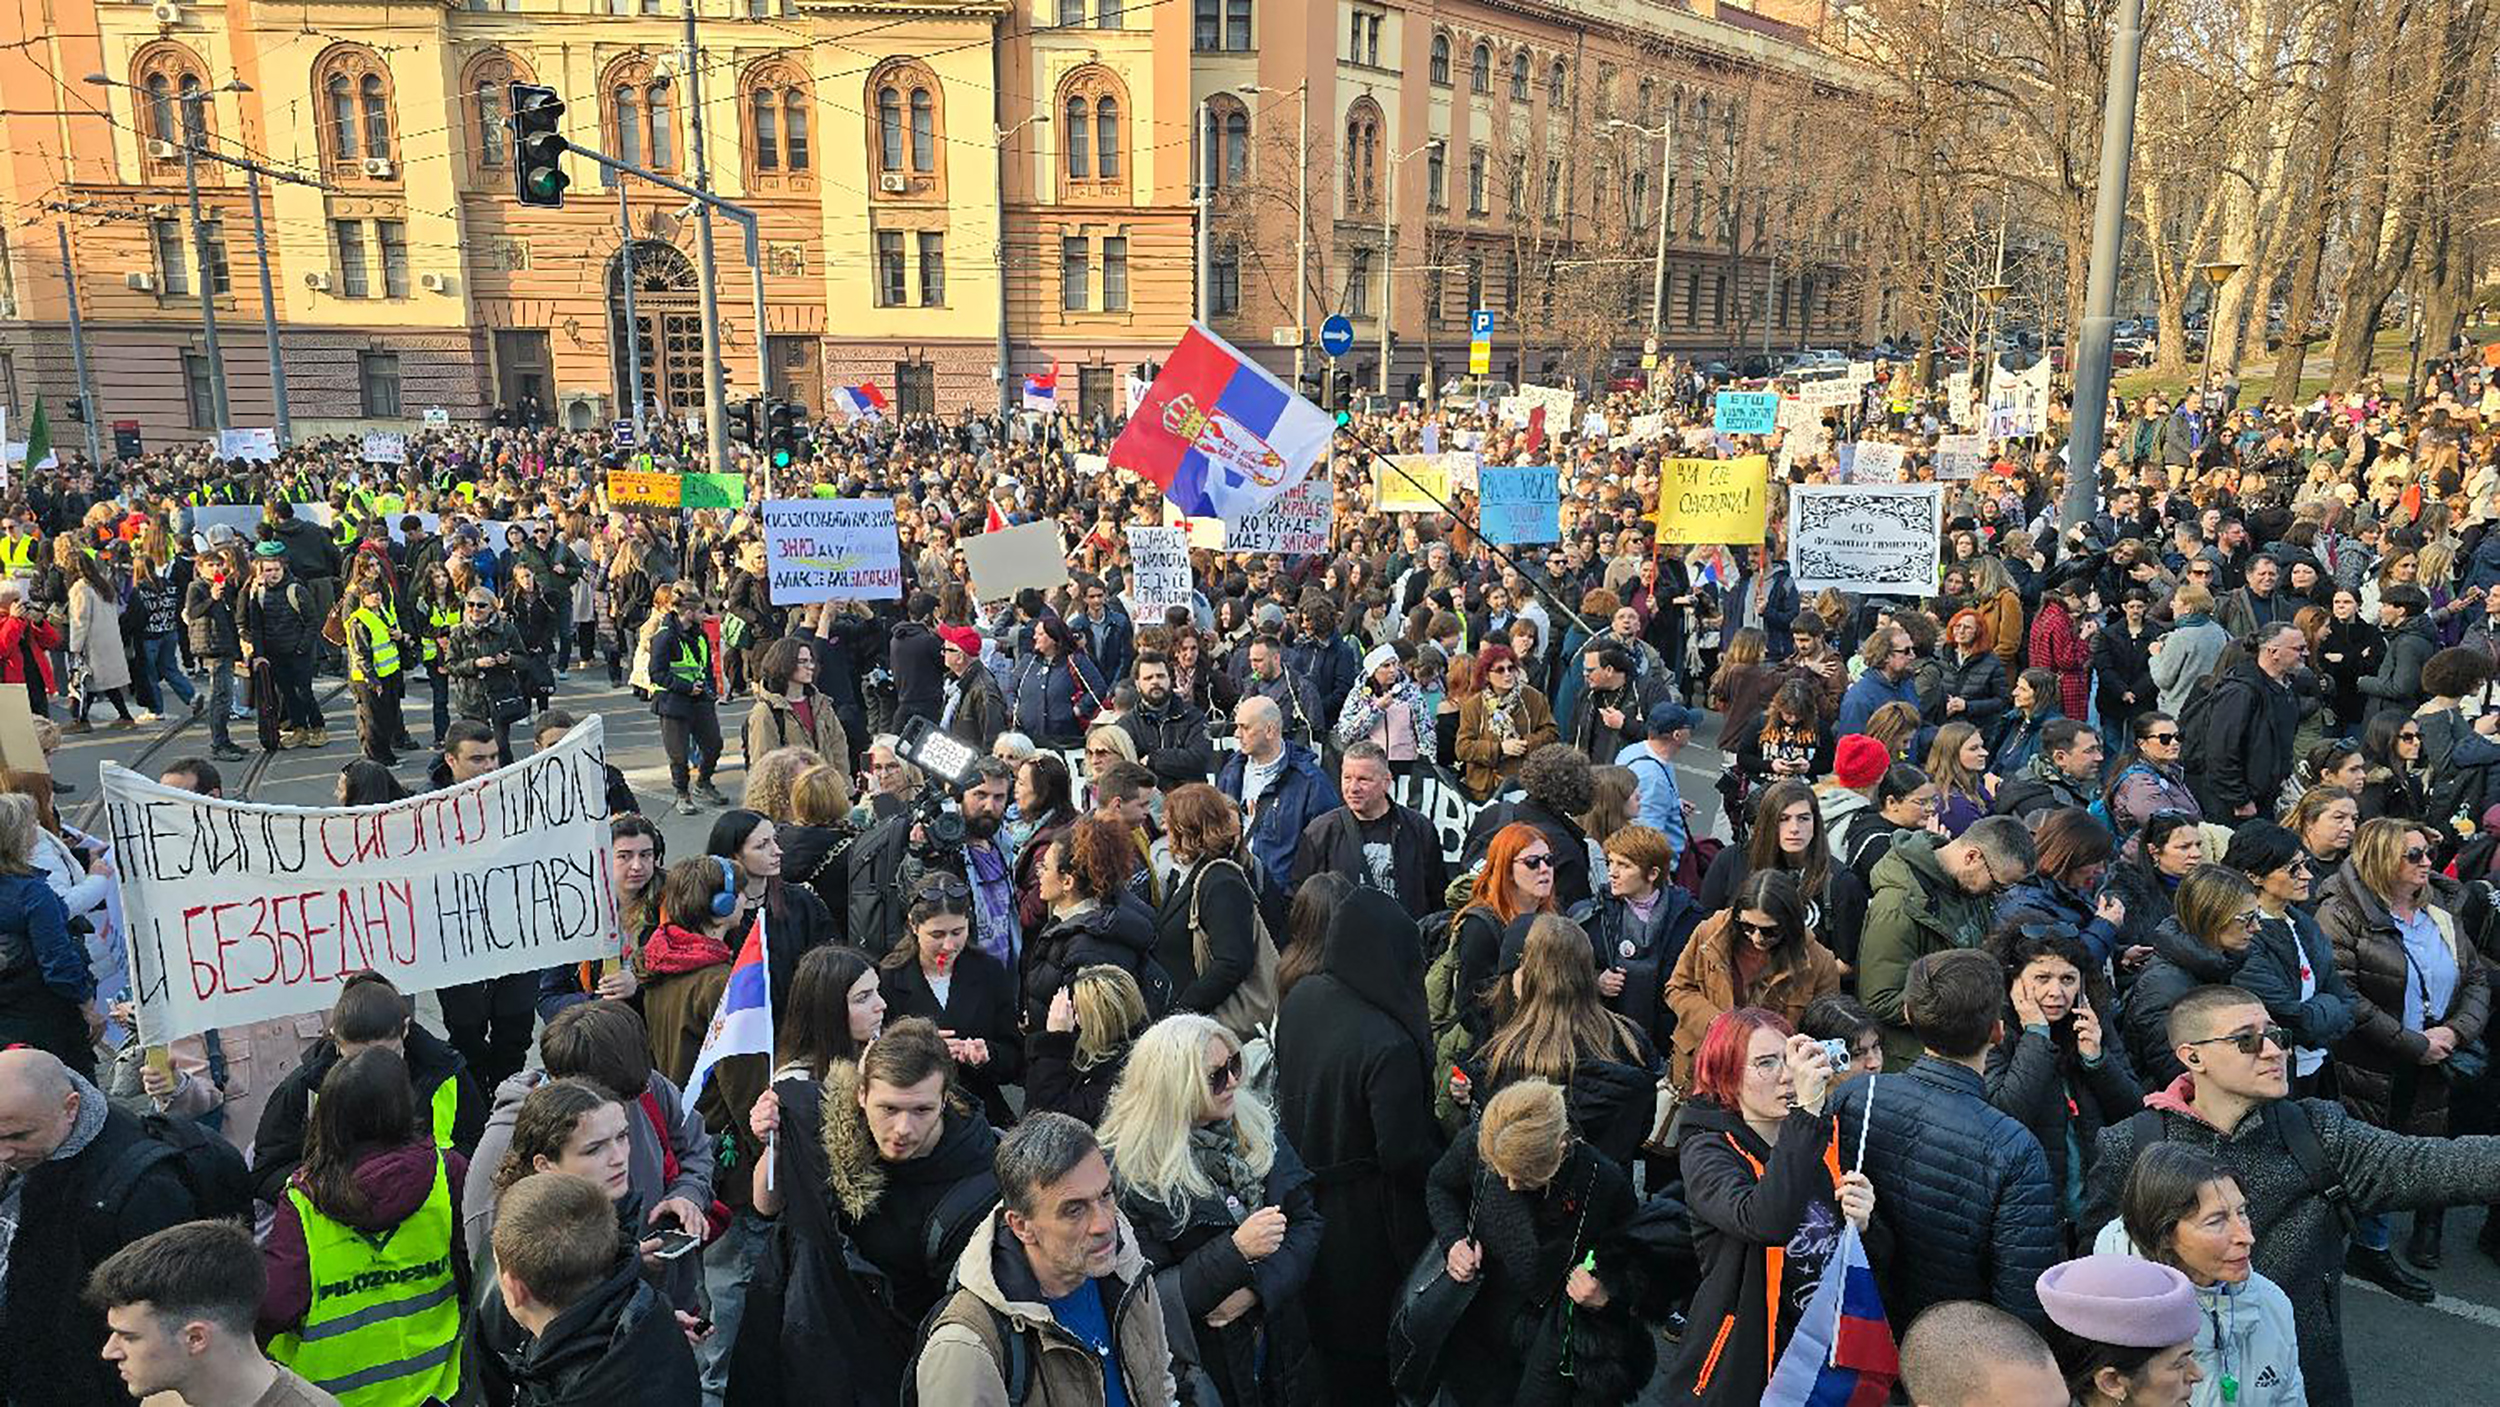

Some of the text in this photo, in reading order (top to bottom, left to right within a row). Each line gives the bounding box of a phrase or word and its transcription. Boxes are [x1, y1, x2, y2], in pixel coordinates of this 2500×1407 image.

[1477, 314, 1490, 331] P
[1677, 463, 1699, 485] ВИ
[1240, 515, 1312, 533] КО КРАДЕ
[1229, 534, 1261, 550] ИДЕ
[1267, 535, 1276, 550] У
[499, 745, 610, 839] ШКОЛУ
[131, 848, 618, 1006] И БЕЗБЕДНУ НАСТАВУ!
